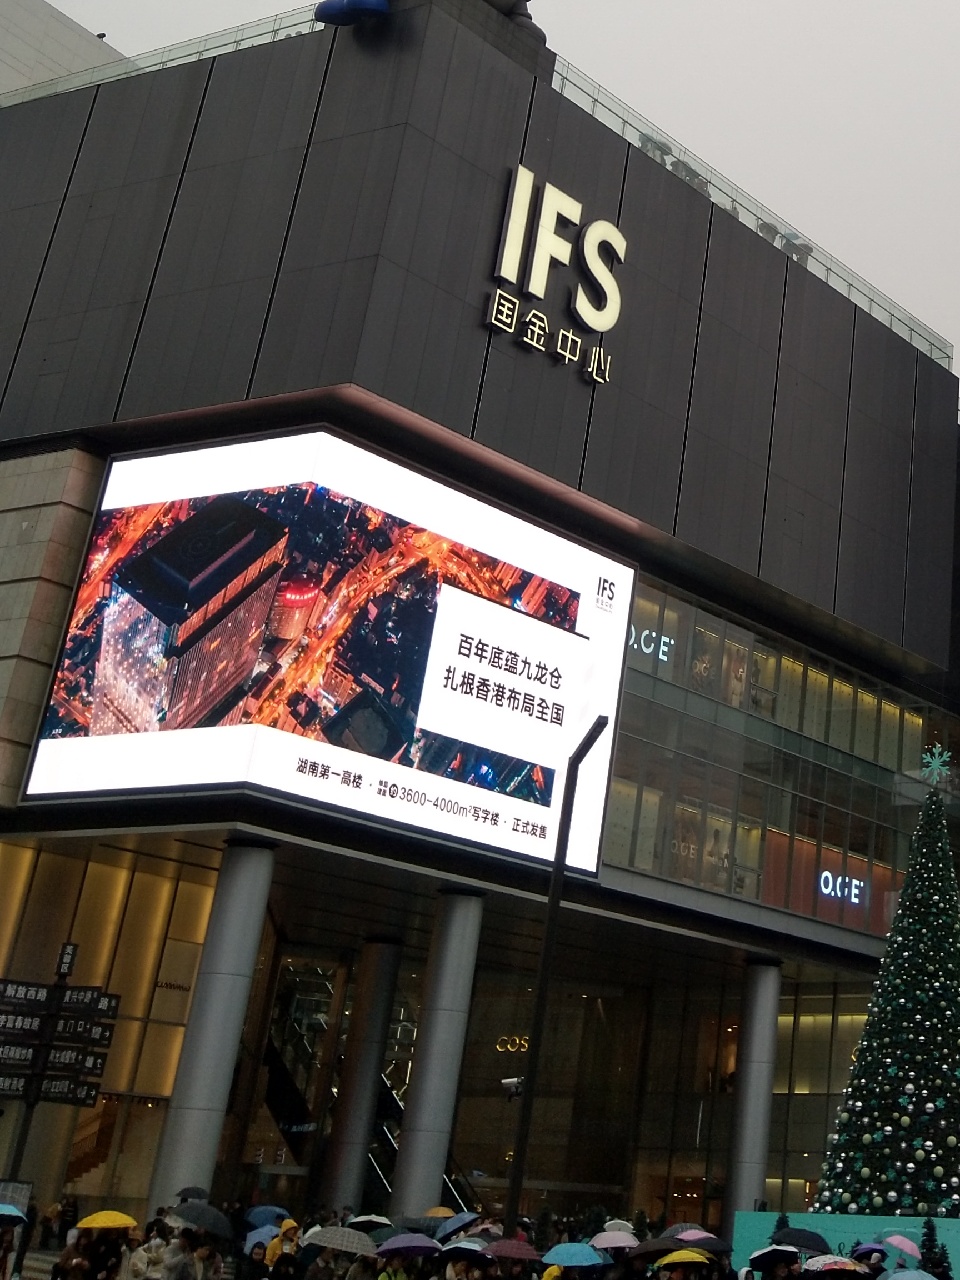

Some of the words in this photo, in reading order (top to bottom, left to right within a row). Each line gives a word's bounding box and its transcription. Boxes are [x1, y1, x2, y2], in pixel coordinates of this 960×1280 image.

[495, 164, 627, 332] IFS
[491, 289, 611, 384] 国金中心
[597, 577, 615, 601] IFS
[458, 633, 562, 689] 百年底蕴九龙仓
[443, 665, 564, 727] 扎根香港布局全国
[296, 757, 362, 790] 湖南第一高楼
[512, 817, 548, 839] 正式发售
[4, 984, 48, 1001] 解放西路
[496, 1036, 529, 1052] COS
